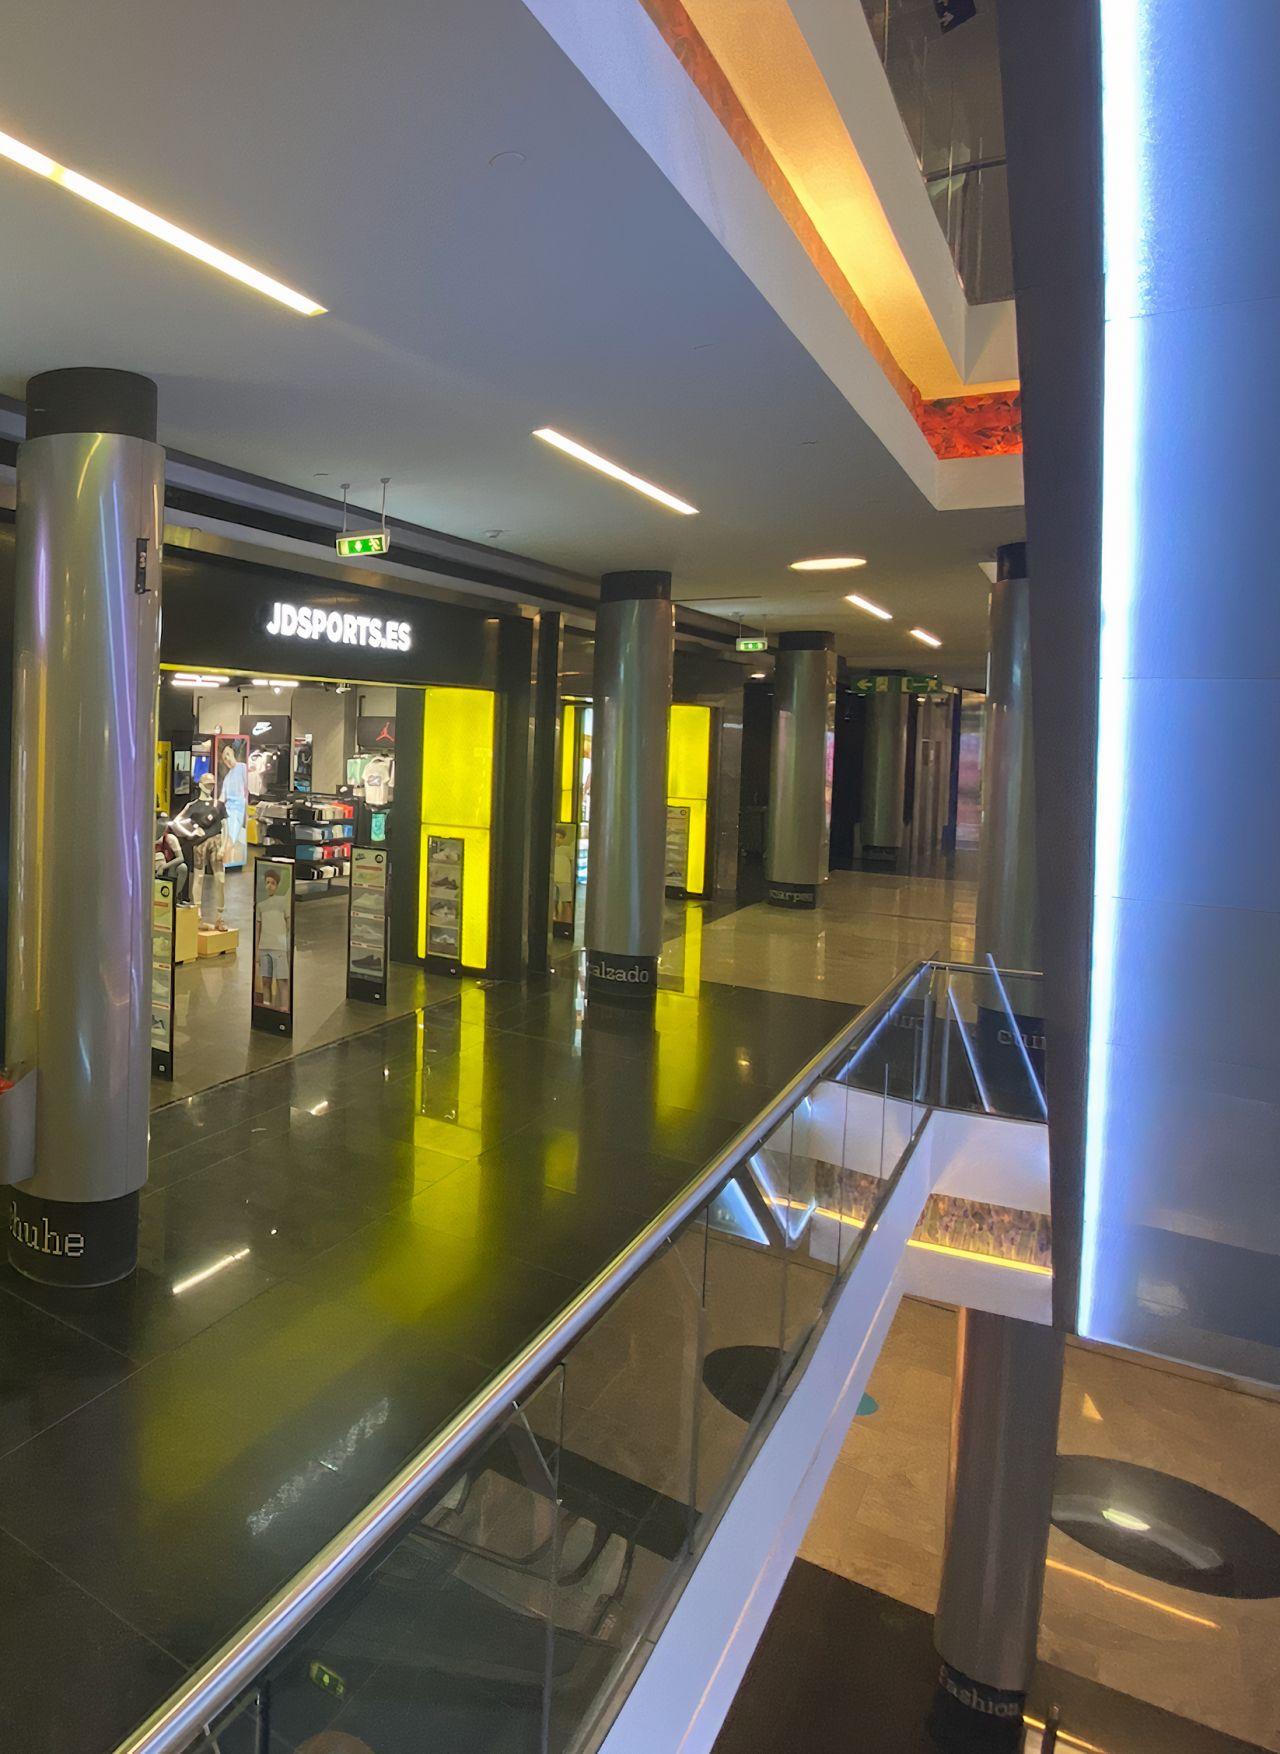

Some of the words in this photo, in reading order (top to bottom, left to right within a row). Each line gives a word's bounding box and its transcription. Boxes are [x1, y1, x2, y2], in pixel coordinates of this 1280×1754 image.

[266, 602, 412, 652] JDSPORTS.ES
[590, 961, 649, 982] alzado
[10, 1200, 85, 1257] huhe
